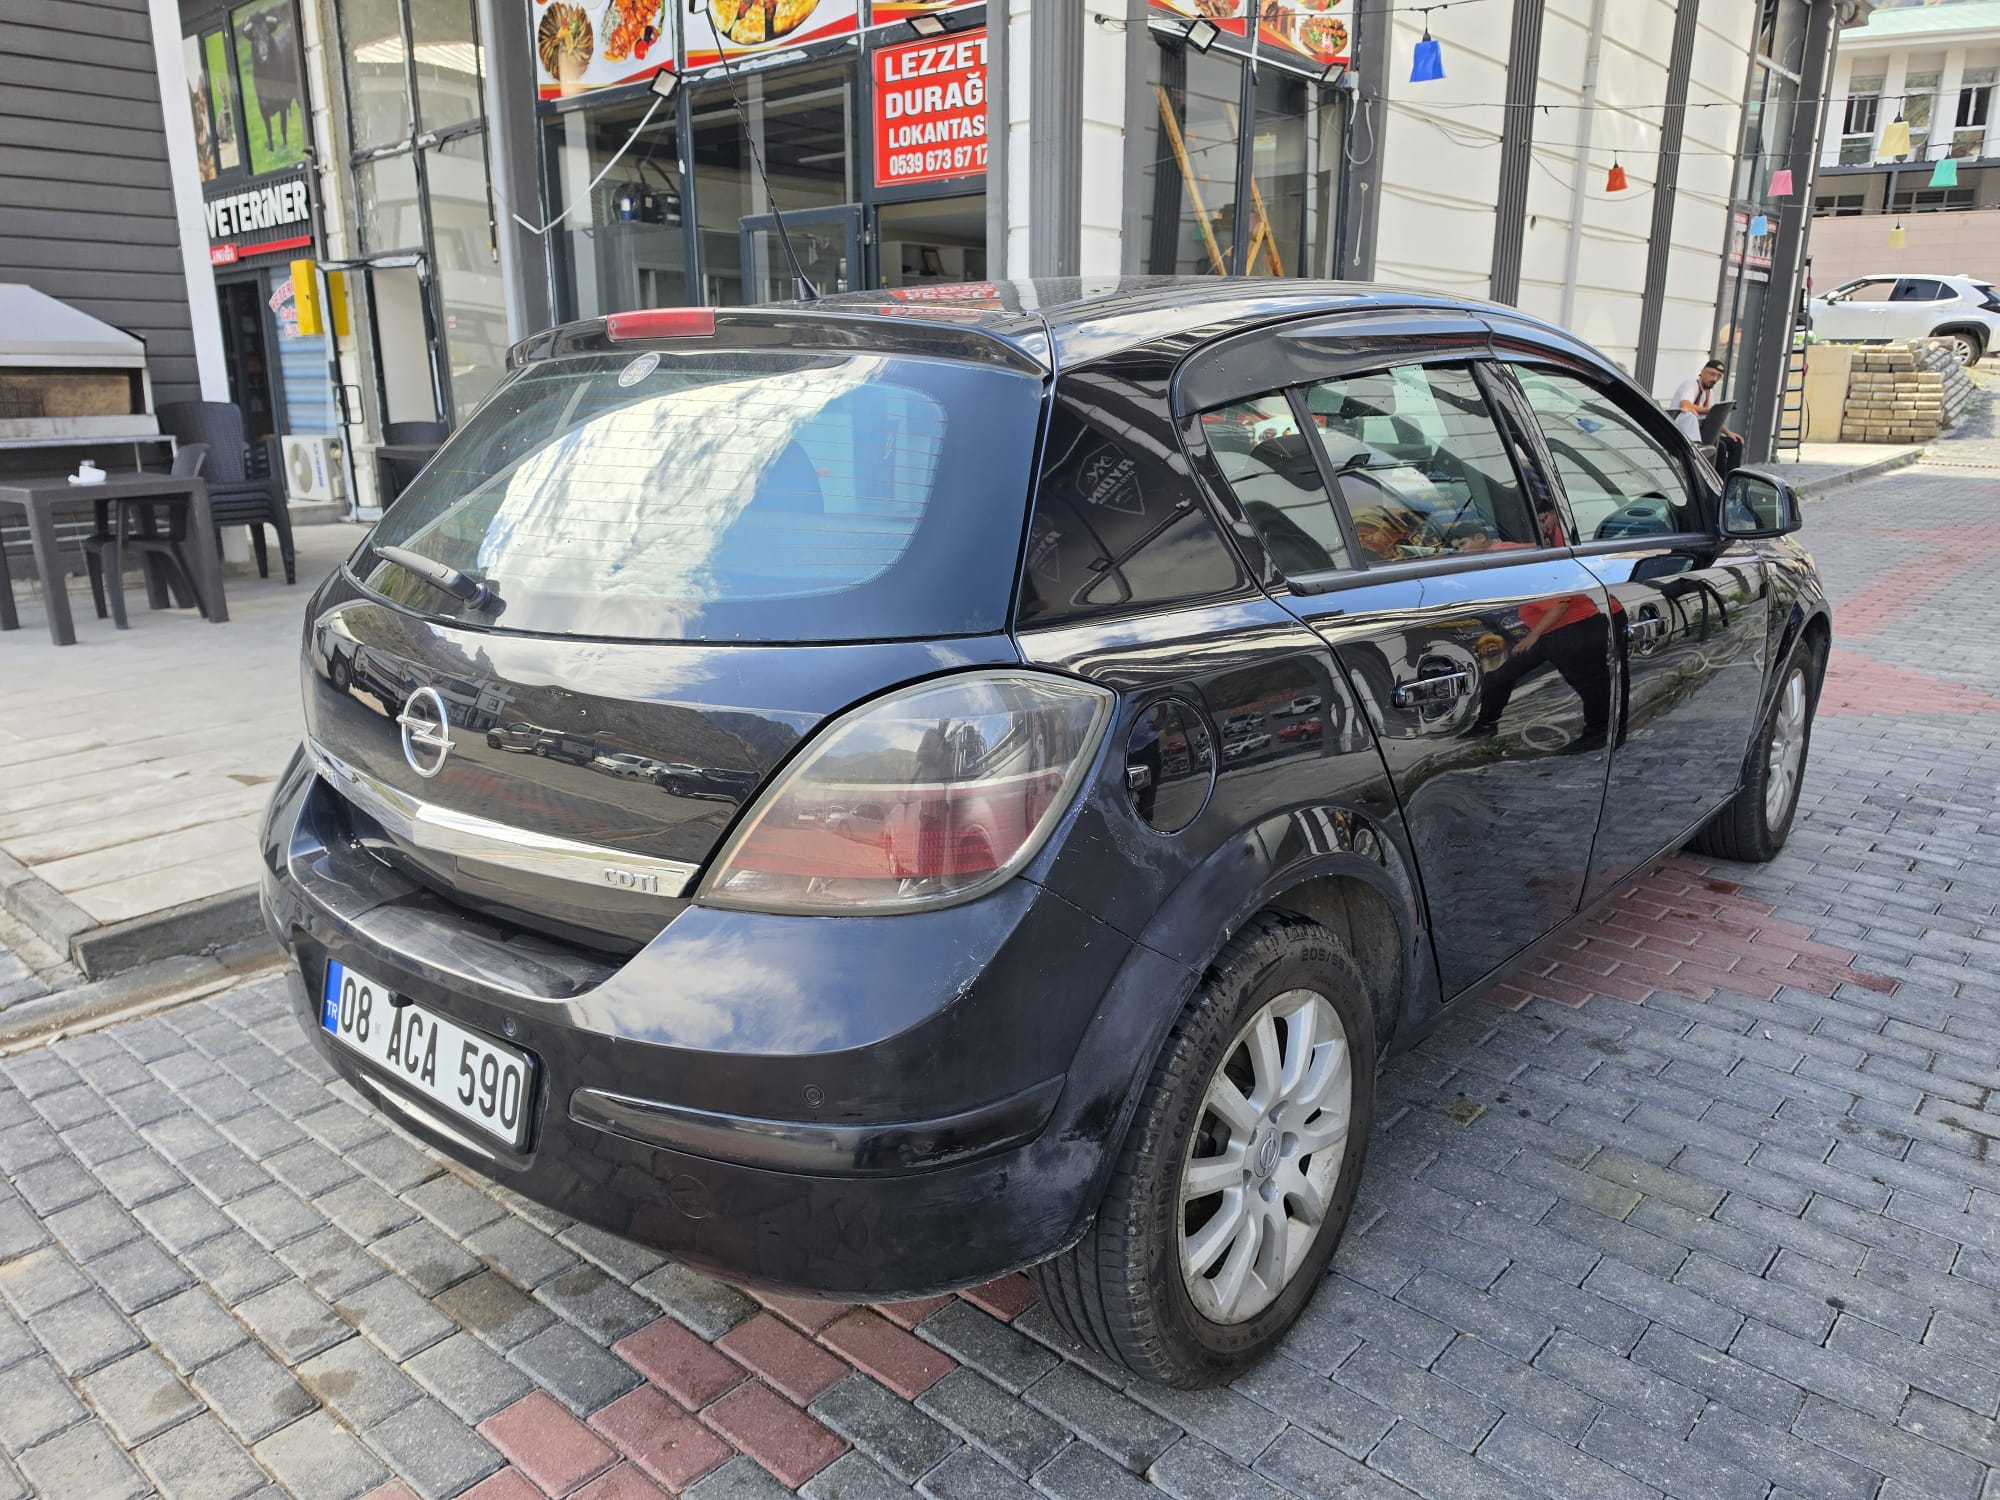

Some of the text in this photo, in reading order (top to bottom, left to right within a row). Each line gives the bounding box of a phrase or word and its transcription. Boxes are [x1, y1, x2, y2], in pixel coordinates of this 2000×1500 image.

[884, 37, 987, 83] LEZZET
[885, 71, 987, 120] DURAĞ
[888, 114, 987, 149] LOKANTAS
[889, 152, 923, 176] 0539
[925, 148, 952, 172] 673
[954, 145, 972, 168] 67
[604, 867, 658, 893] CDTI
[1301, 947, 1346, 970] 205/55
[326, 999, 338, 1020] TR
[341, 976, 521, 1131] 08 ACA 590
